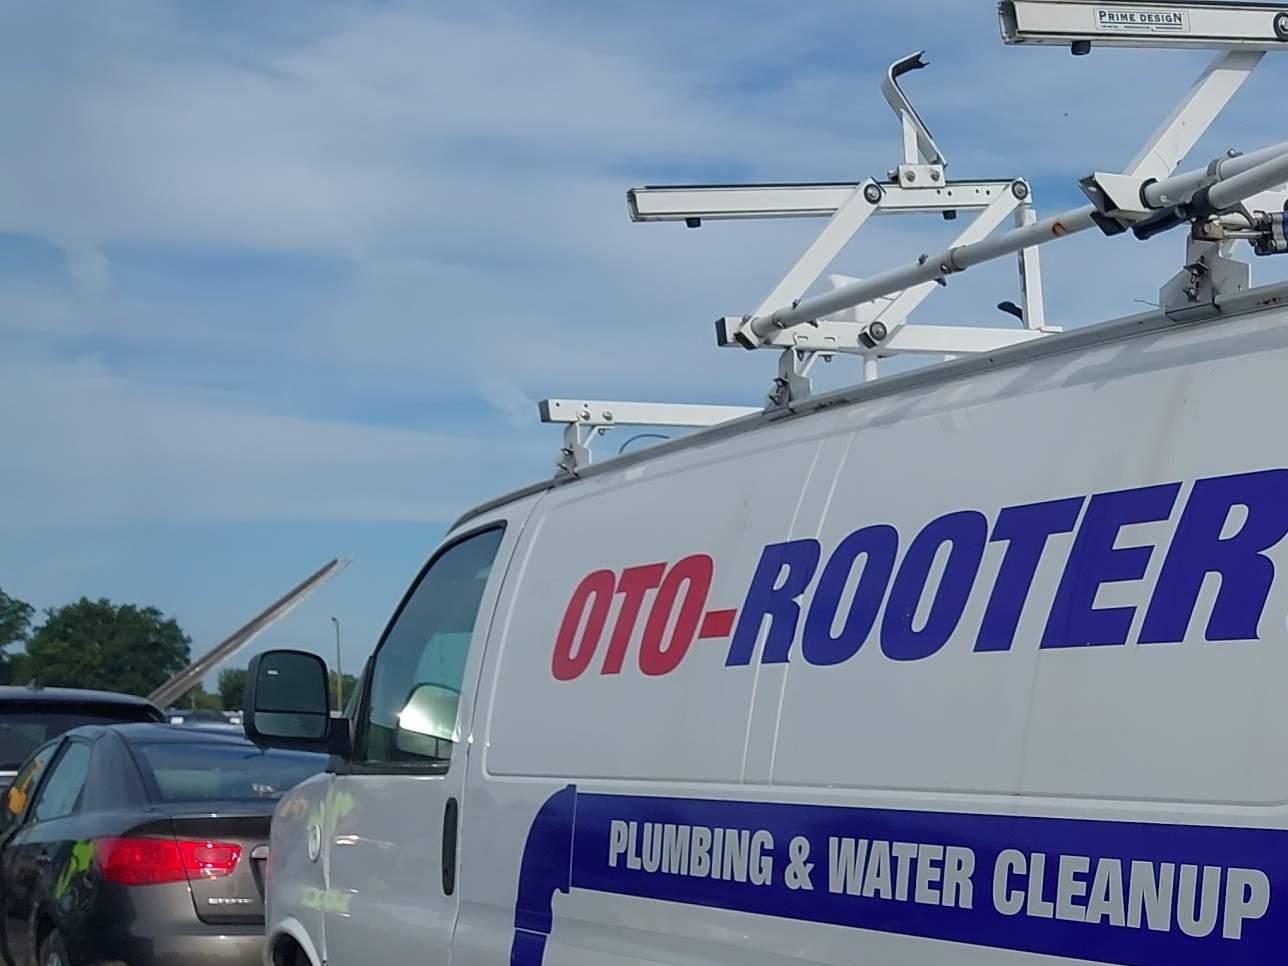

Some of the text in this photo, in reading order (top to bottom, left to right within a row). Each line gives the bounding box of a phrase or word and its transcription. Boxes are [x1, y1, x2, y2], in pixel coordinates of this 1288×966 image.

[1099, 10, 1182, 23] PRIME DESIGN
[608, 819, 1271, 940] PLUMBING & WATER CLEANUP
